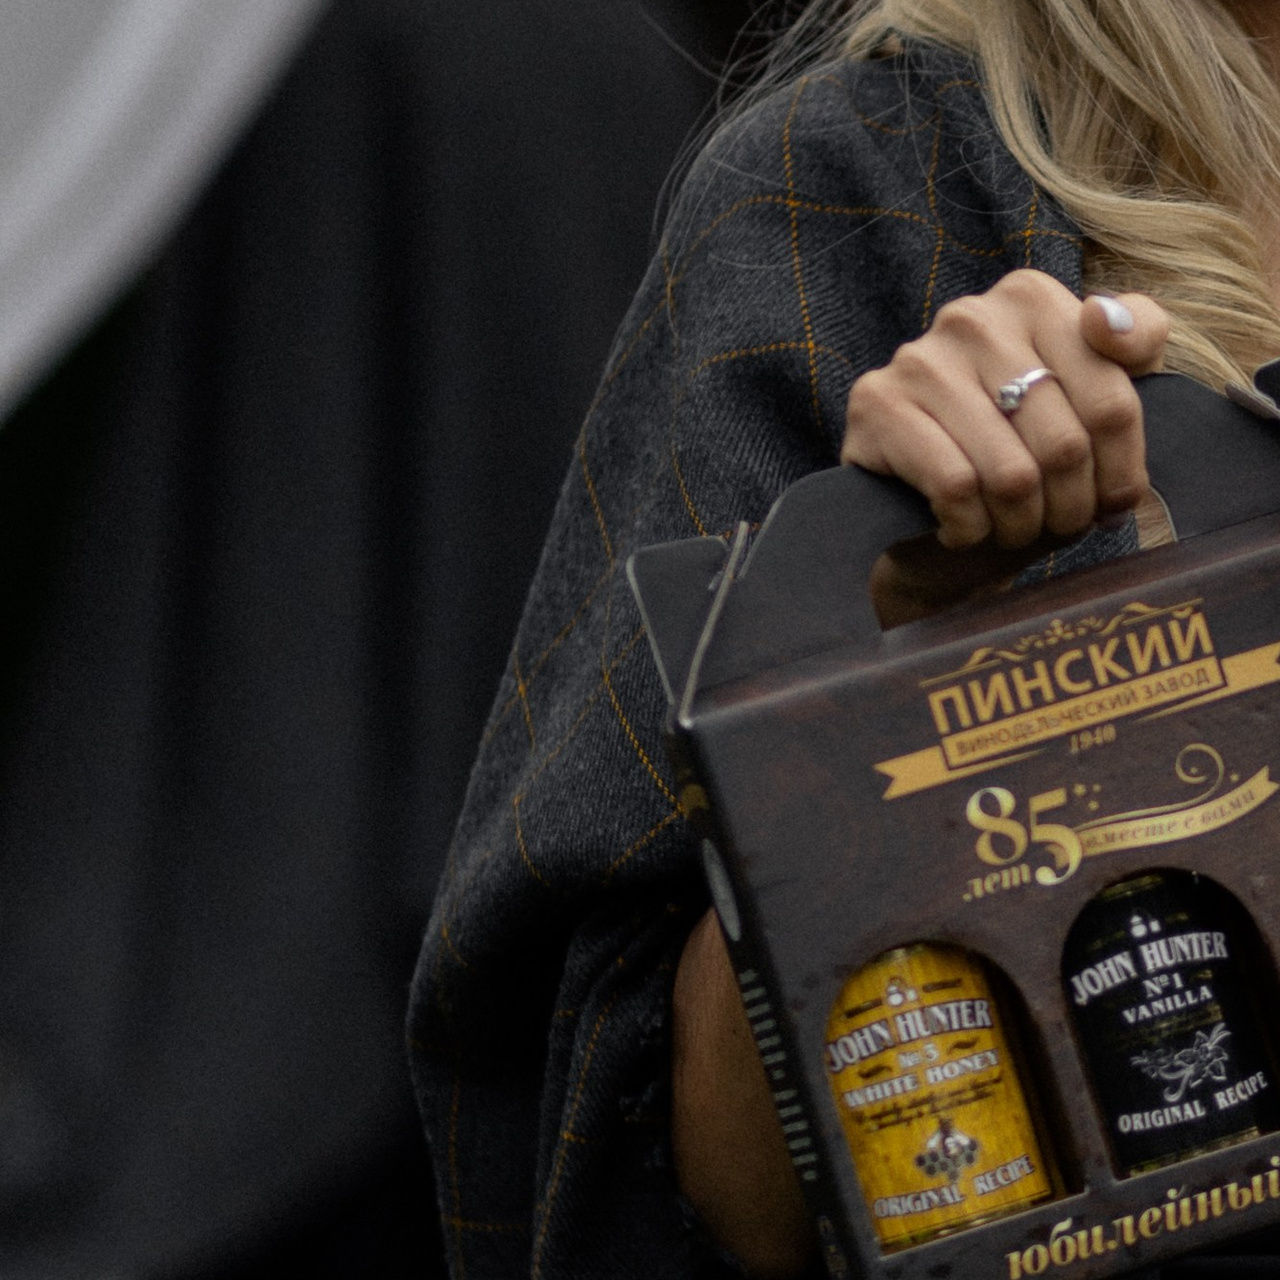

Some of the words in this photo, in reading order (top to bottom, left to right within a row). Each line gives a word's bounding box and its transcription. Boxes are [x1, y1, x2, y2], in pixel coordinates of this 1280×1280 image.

[928, 605, 1214, 735] ПИНСКИЙ
[1142, 667, 1212, 700] ЗАВОД
[965, 786, 1083, 886] 85
[1070, 950, 1139, 1007] JOHN
[1138, 931, 1229, 972] HUNTER
[827, 1020, 894, 1072] JOHN
[895, 999, 993, 1042] HUNTER
[1121, 985, 1213, 1025] VANILLA
[843, 1073, 919, 1110] WHITE
[924, 1049, 1001, 1085] HONEY
[1117, 1099, 1206, 1134] ORIGINAL
[1212, 1071, 1269, 1111] RECIPE
[873, 1182, 966, 1220] ORIGINAL
[972, 1154, 1036, 1197] RECIPE
